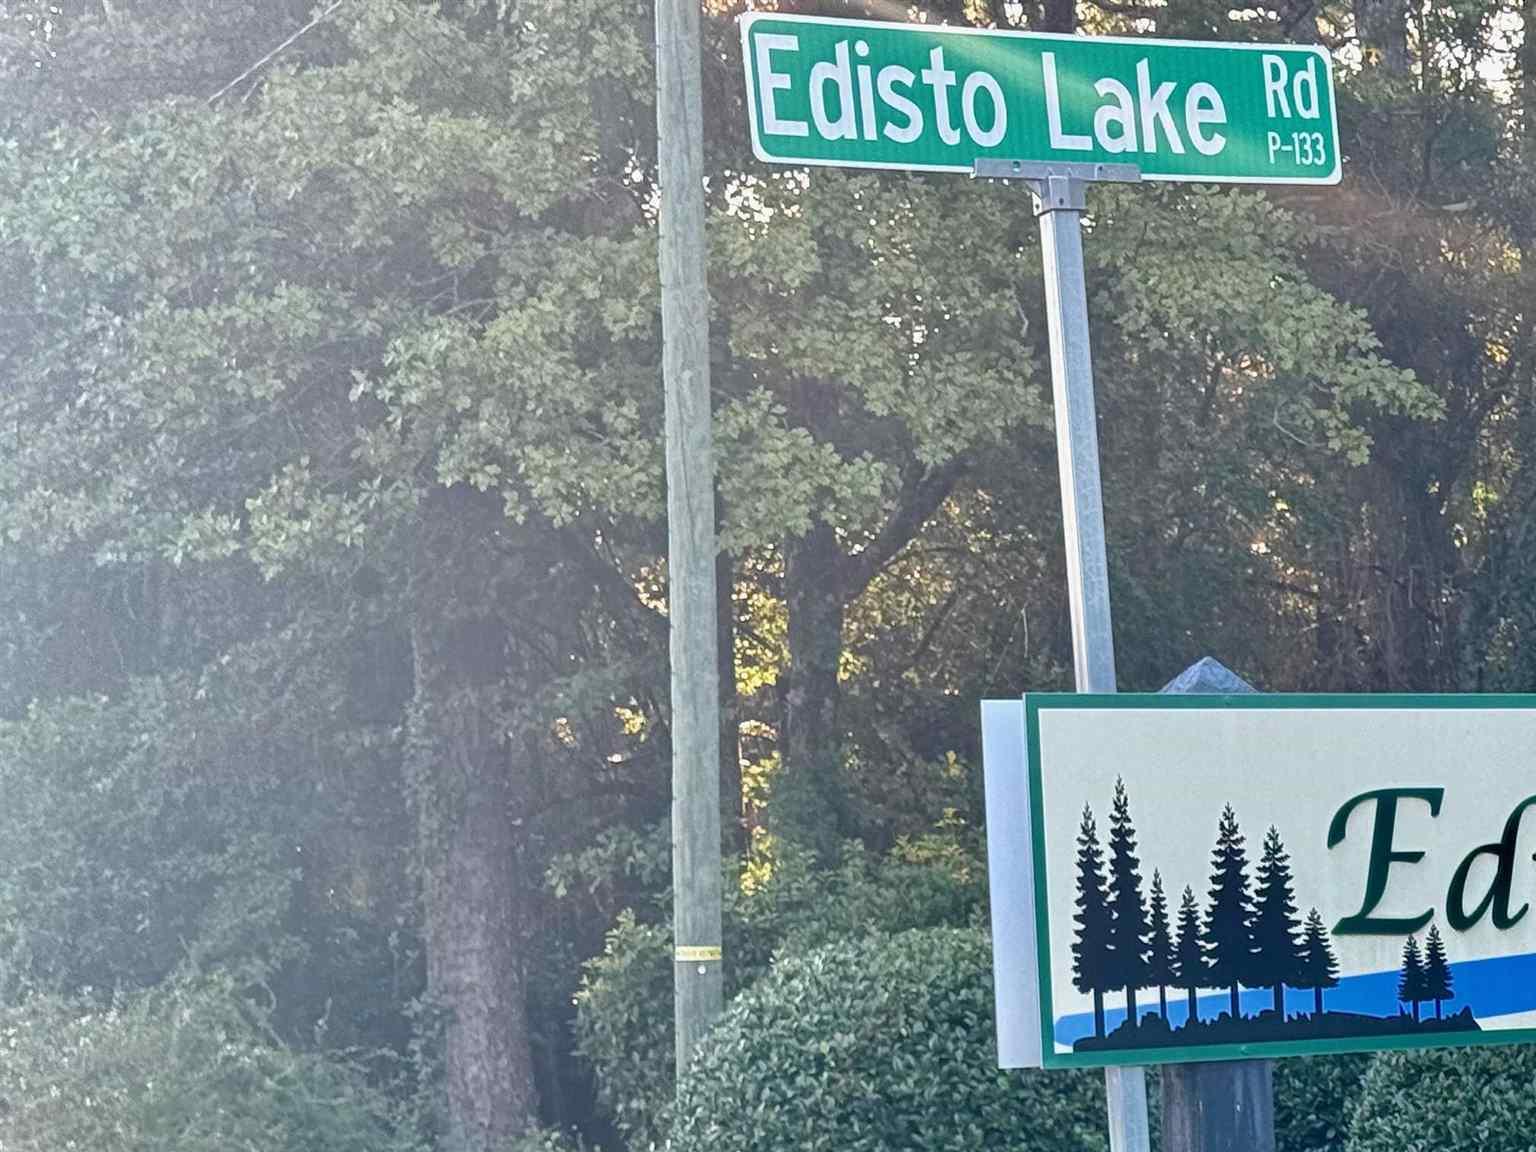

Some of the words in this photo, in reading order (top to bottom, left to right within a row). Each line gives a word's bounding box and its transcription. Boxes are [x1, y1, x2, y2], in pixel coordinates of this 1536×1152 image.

[754, 32, 1007, 148] Edisto
[1041, 51, 1228, 155] Lake
[1262, 54, 1320, 119] Rd
[1267, 131, 1326, 165] P-133
